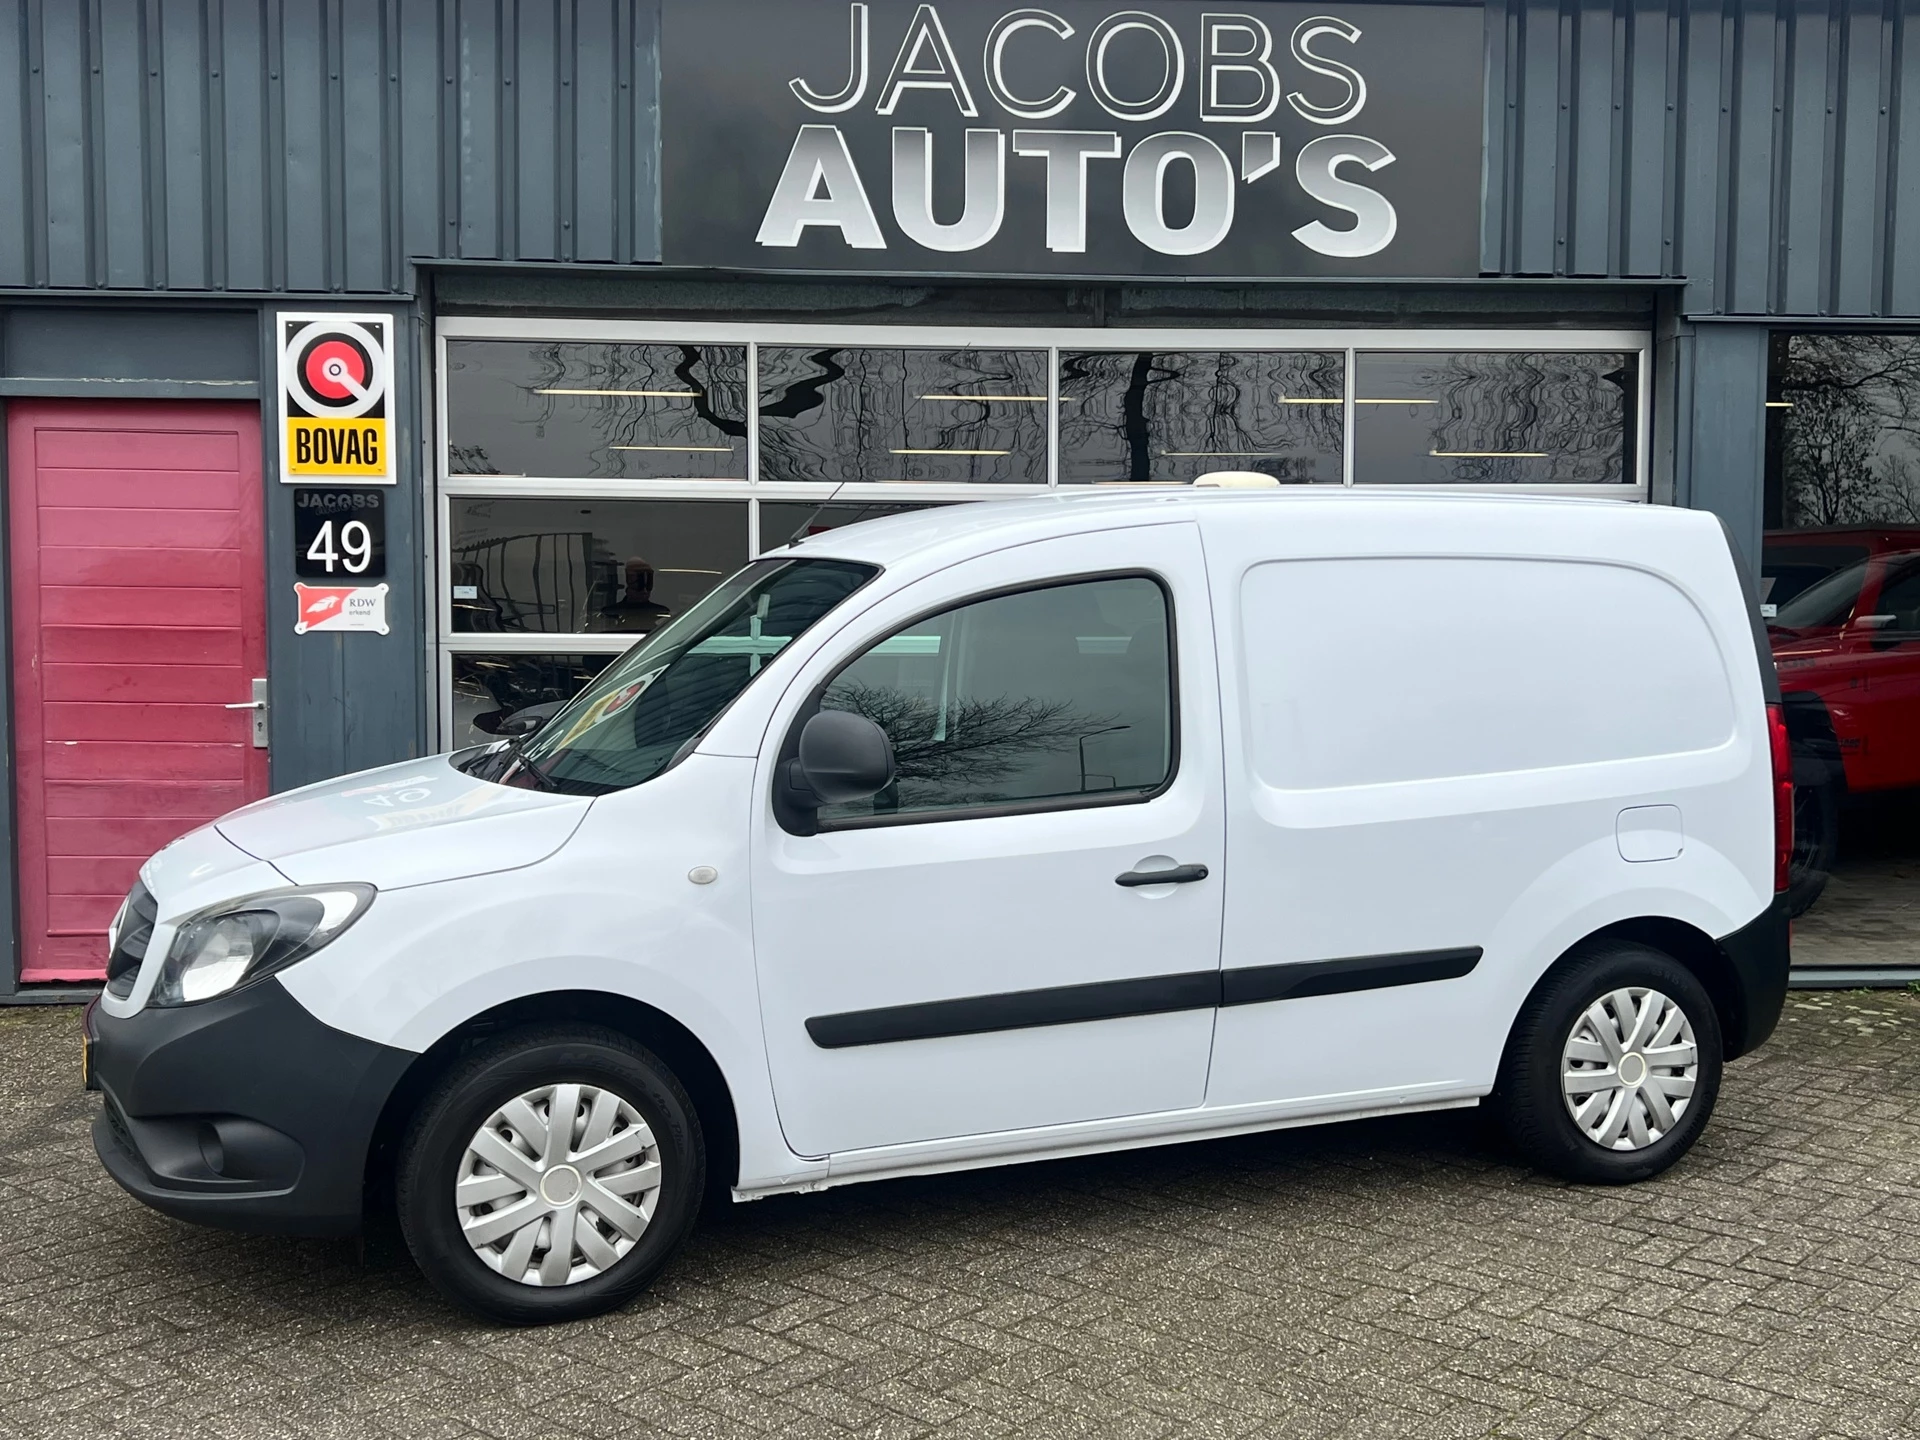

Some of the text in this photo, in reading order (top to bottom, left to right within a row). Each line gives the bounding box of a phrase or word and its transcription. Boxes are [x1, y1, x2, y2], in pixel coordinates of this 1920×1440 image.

[789, 2, 1368, 125] JACOBS
[754, 123, 1398, 258] AUTO'S
[296, 427, 378, 466] BOVAG
[297, 493, 379, 509] JACOBS
[307, 520, 371, 573] 49
[349, 598, 376, 608] RDW
